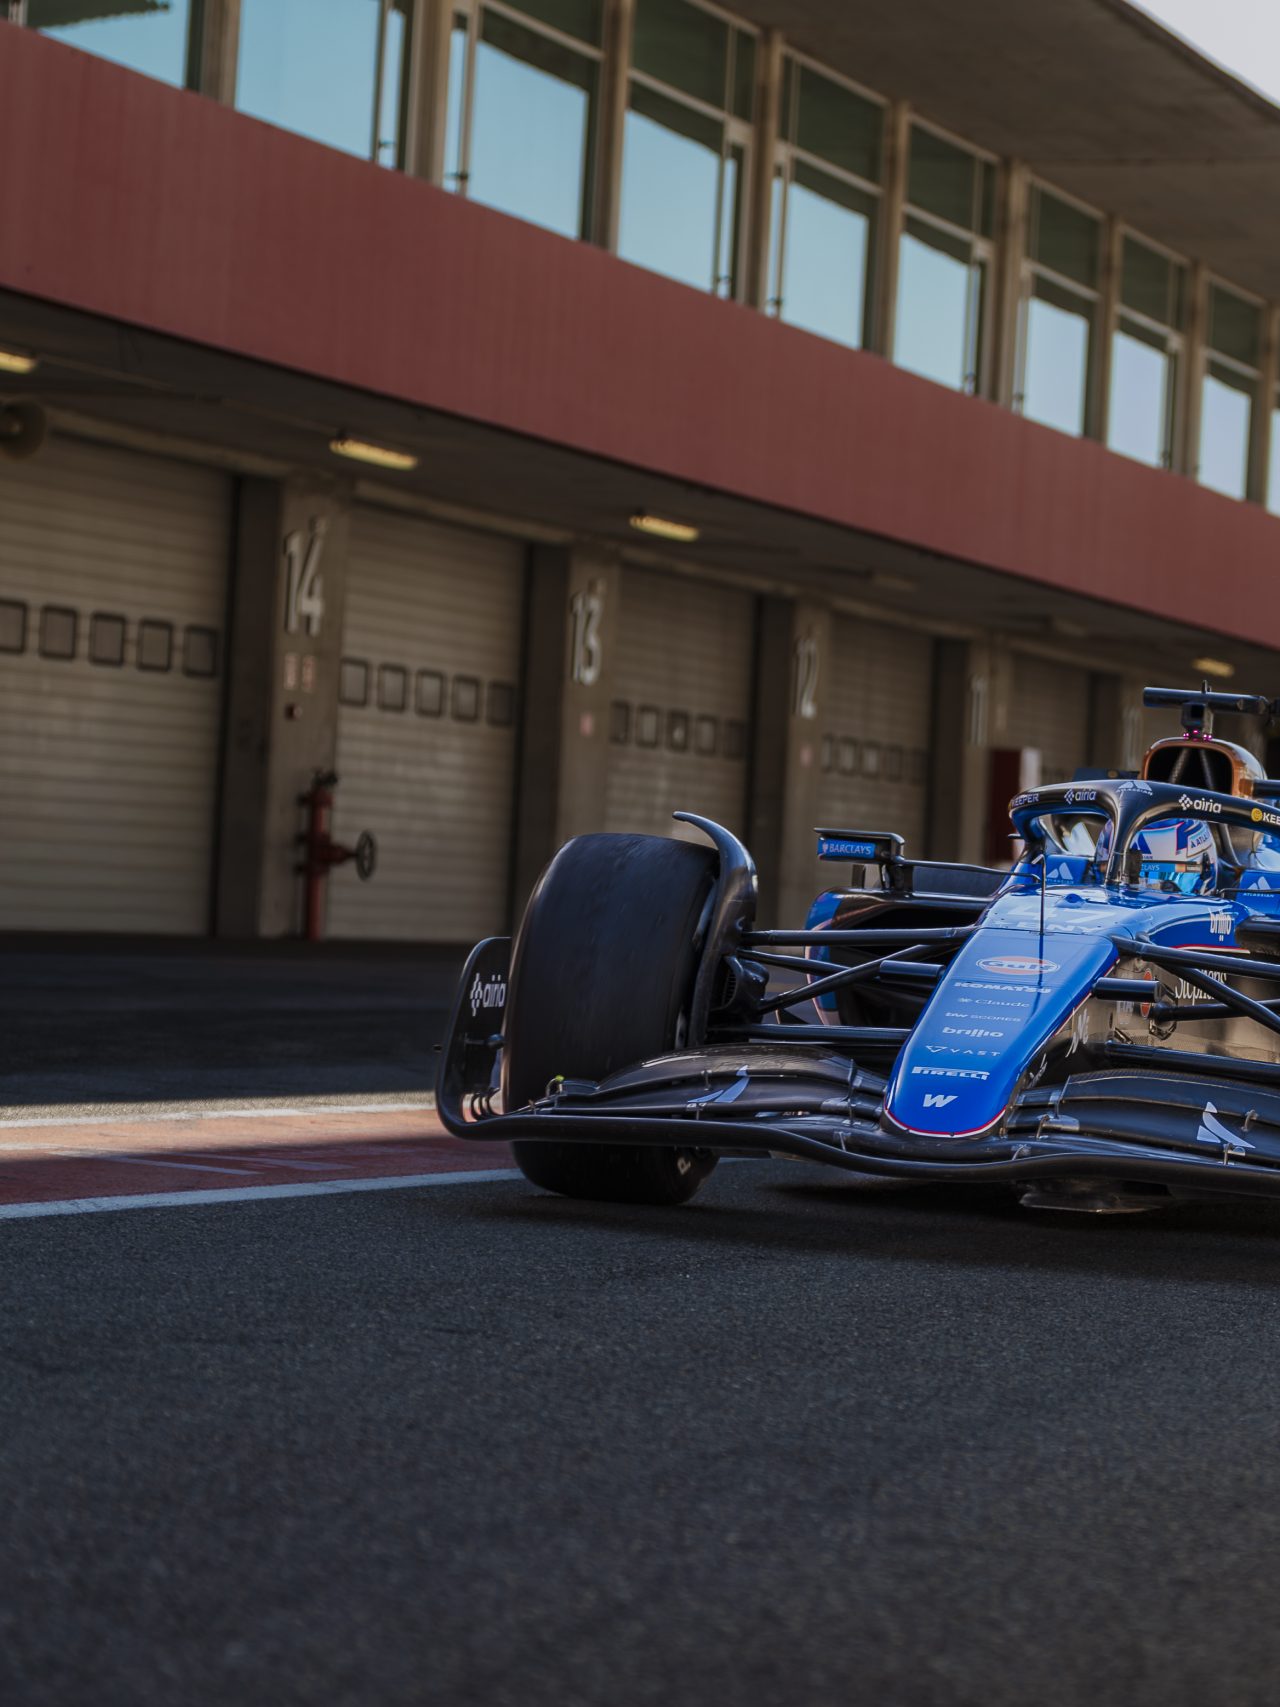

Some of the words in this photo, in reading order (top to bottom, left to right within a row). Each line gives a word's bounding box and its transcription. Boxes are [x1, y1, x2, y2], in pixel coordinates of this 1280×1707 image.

[286, 530, 323, 637] 14
[572, 593, 602, 686] 13
[1074, 788, 1097, 801] airia
[1193, 800, 1222, 814] airia
[829, 843, 872, 855] BARCLAYS
[983, 959, 1057, 973] Gulf
[483, 974, 507, 1008] airia
[954, 982, 1052, 994] KOMATSU
[975, 999, 1030, 1008] Claude
[942, 1026, 1004, 1038] brillio
[950, 1048, 1001, 1057] VAST
[911, 1066, 990, 1081] PIRELLI
[923, 1094, 958, 1108] W
